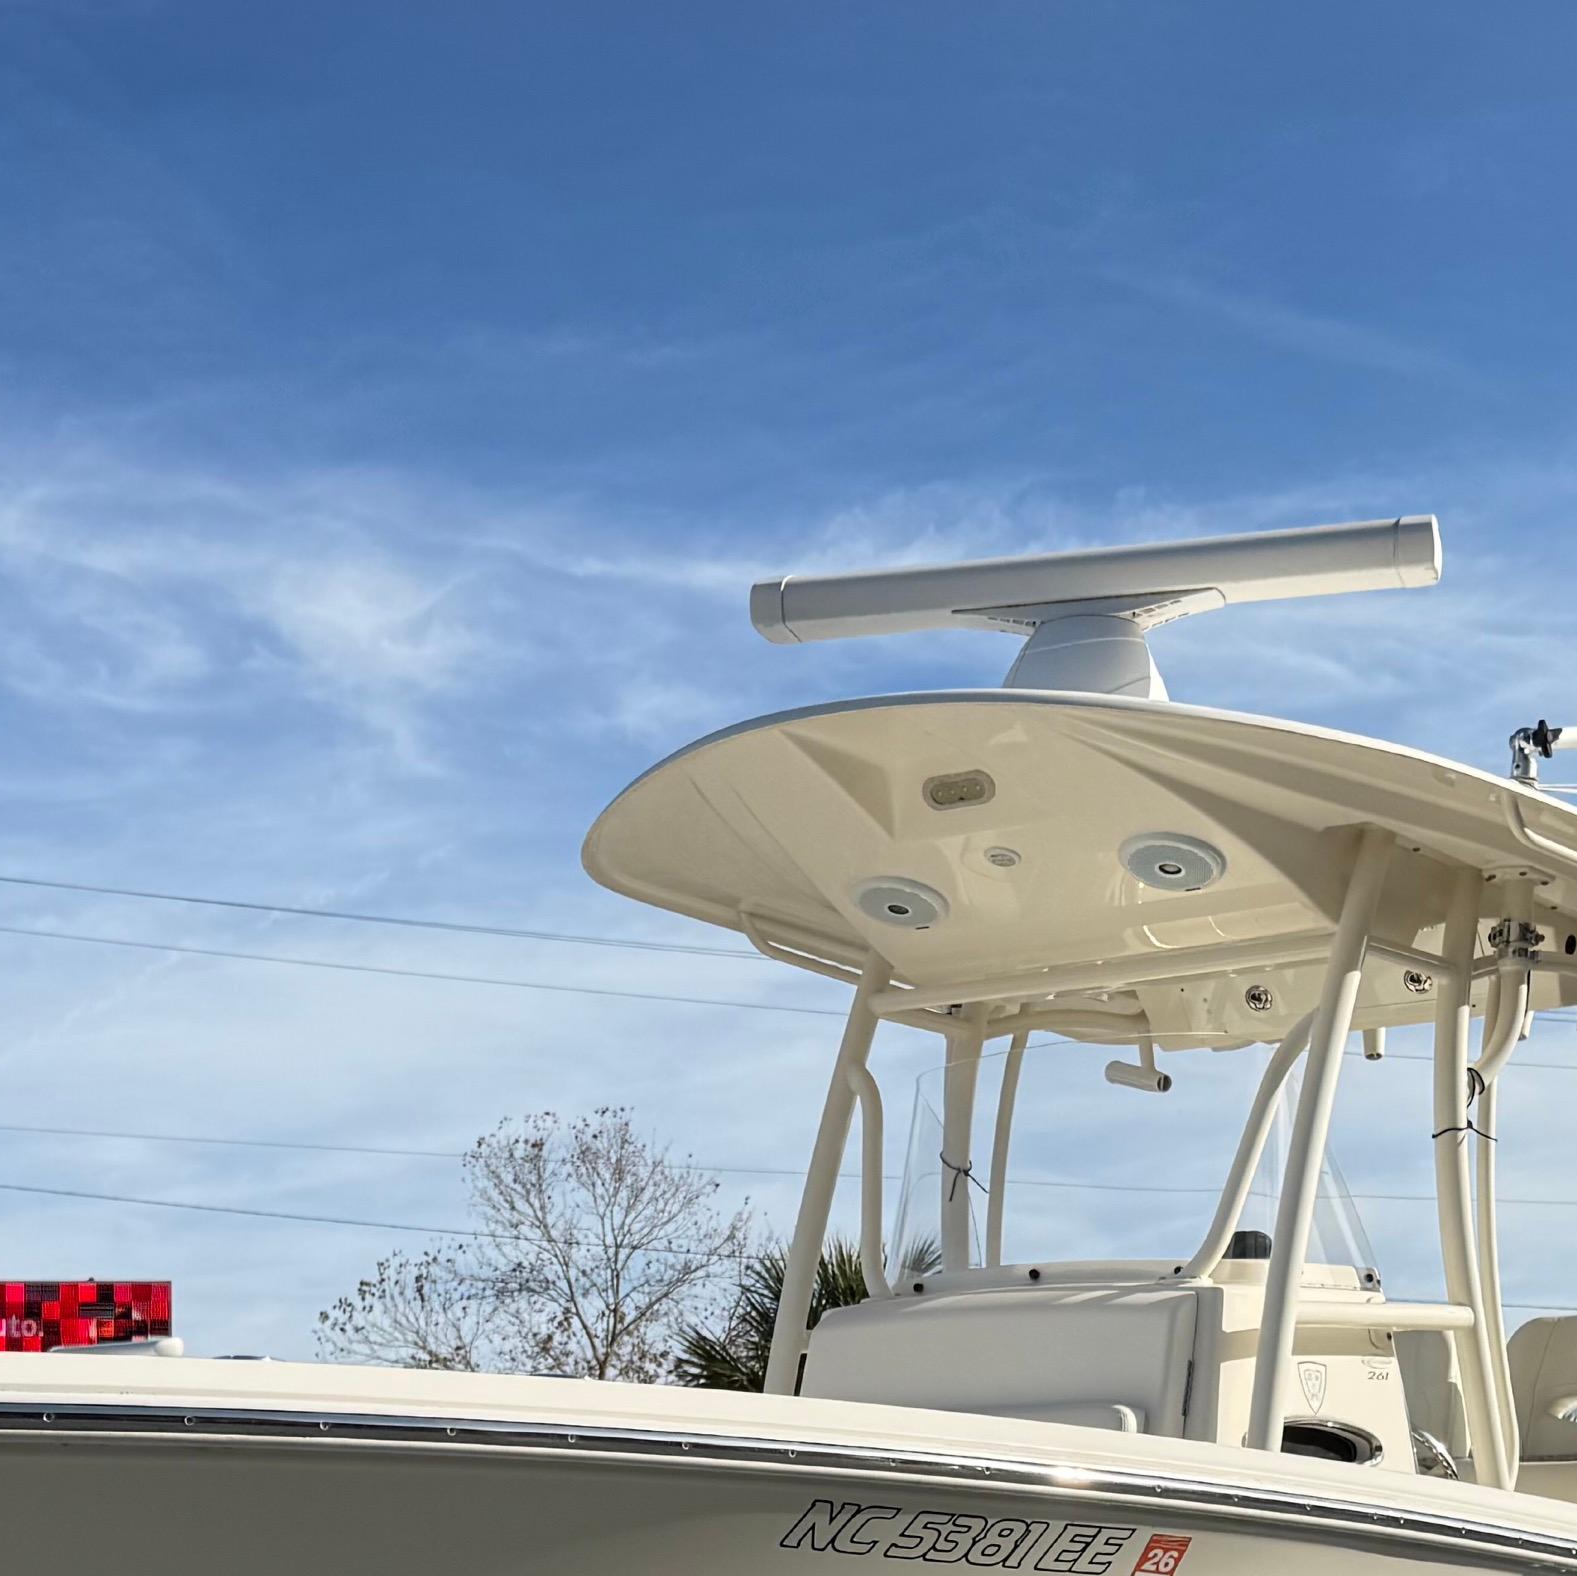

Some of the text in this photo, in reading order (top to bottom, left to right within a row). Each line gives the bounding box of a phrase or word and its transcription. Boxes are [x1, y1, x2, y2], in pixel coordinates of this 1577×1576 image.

[1367, 1370, 1389, 1381] 261
[780, 1499, 1137, 1575] NC 5381 EE
[1139, 1548, 1180, 1573] 26
